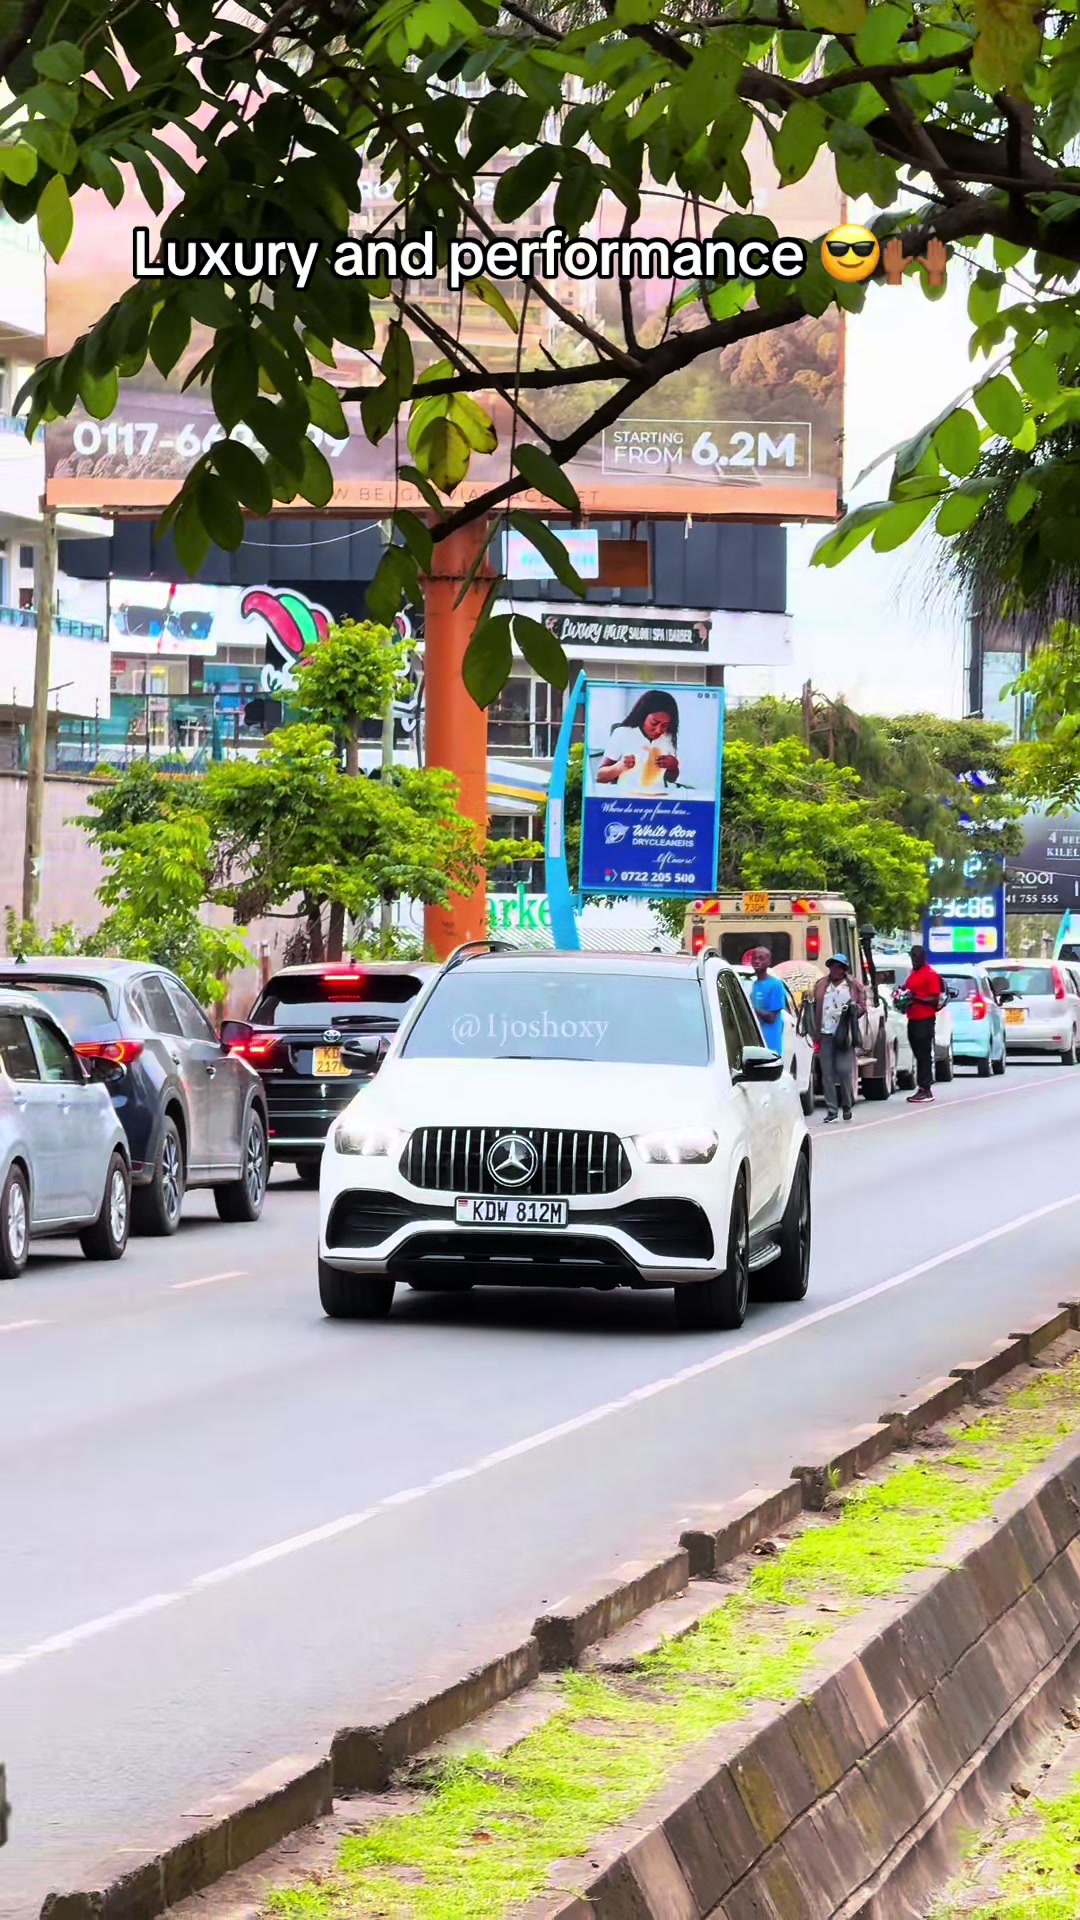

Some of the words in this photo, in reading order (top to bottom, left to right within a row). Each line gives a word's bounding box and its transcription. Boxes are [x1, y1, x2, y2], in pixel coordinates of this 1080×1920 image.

[613, 431, 684, 444] STARTING
[614, 446, 683, 464] FROM
[691, 431, 796, 467] 6.2M
[632, 824, 668, 838] White
[1048, 832, 1057, 843] 4
[632, 838, 694, 848] DRYCLEANERS
[621, 871, 649, 882] 0722
[650, 872, 672, 883] 205
[1020, 894, 1038, 903] 755
[473, 1200, 508, 1222] KDW
[516, 1202, 562, 1224] 812M
